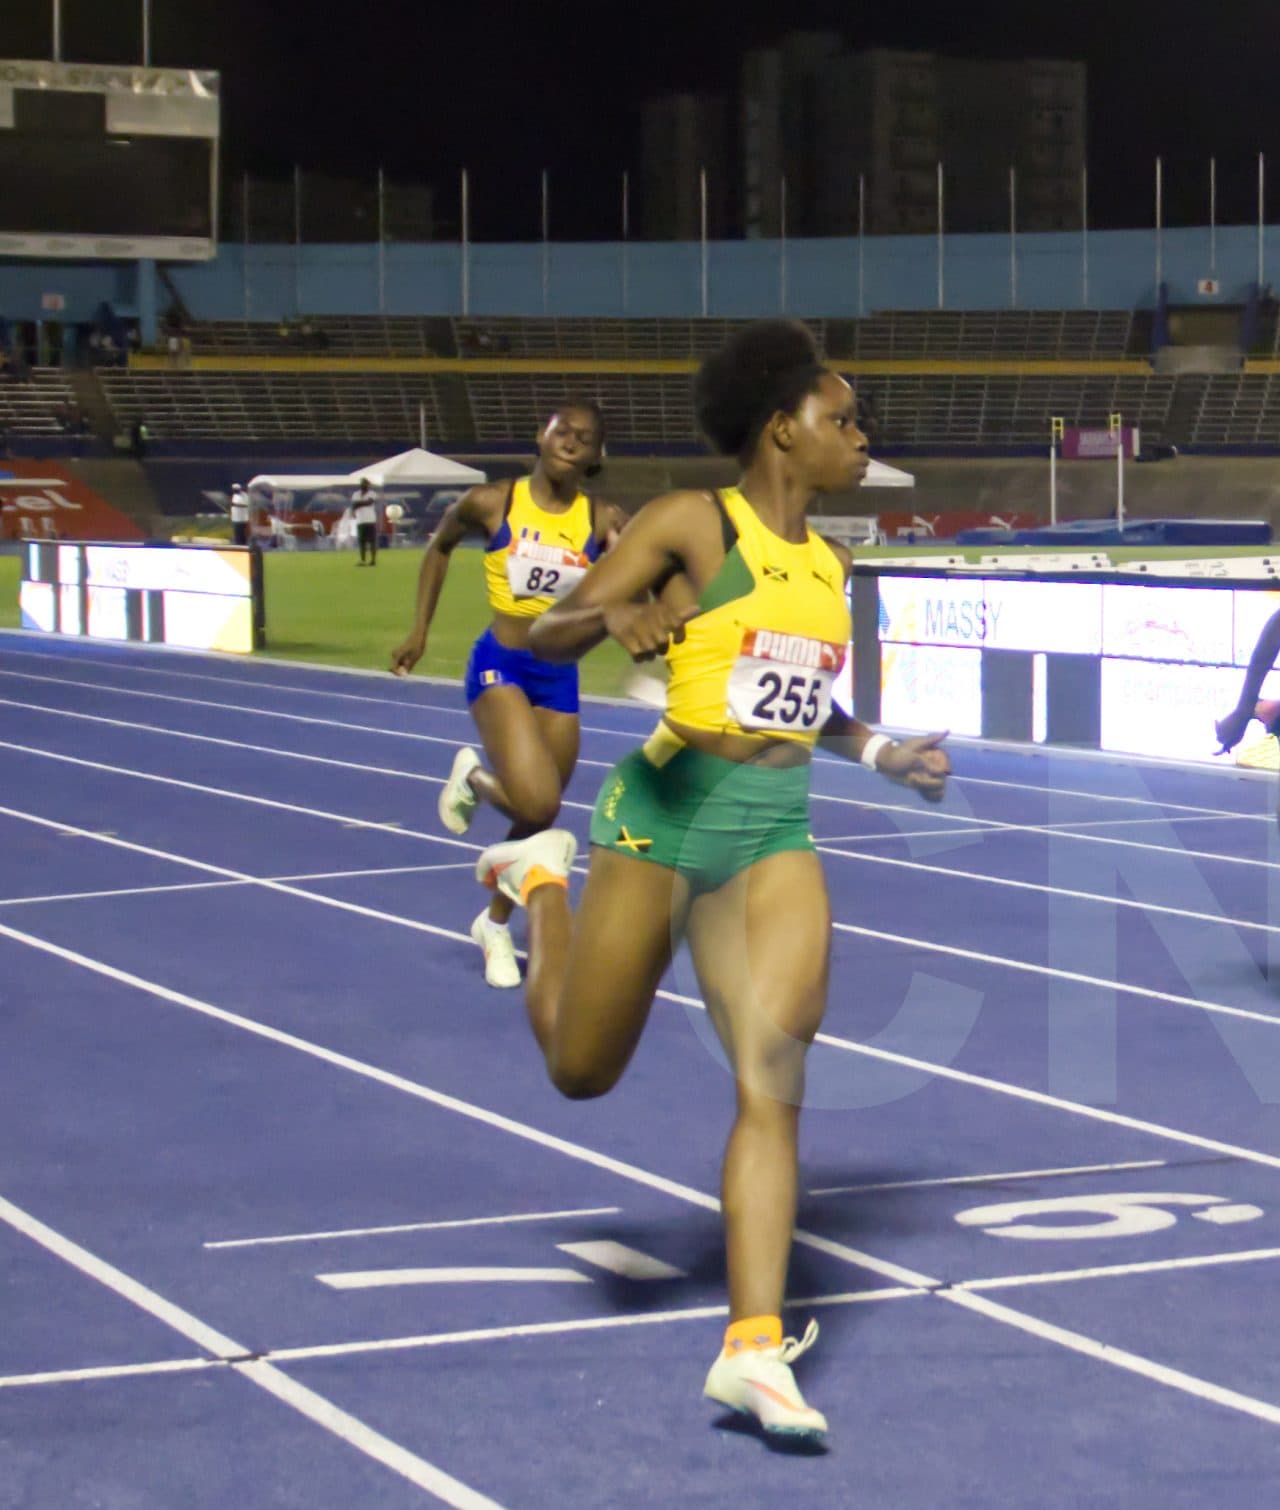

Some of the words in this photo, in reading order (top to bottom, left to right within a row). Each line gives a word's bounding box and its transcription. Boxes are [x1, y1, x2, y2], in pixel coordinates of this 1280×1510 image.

[527, 566, 560, 593] 82
[925, 598, 1003, 641] MASSY
[752, 629, 822, 669] PUMA
[752, 671, 822, 727] 255
[953, 1192, 1265, 1240] 6
